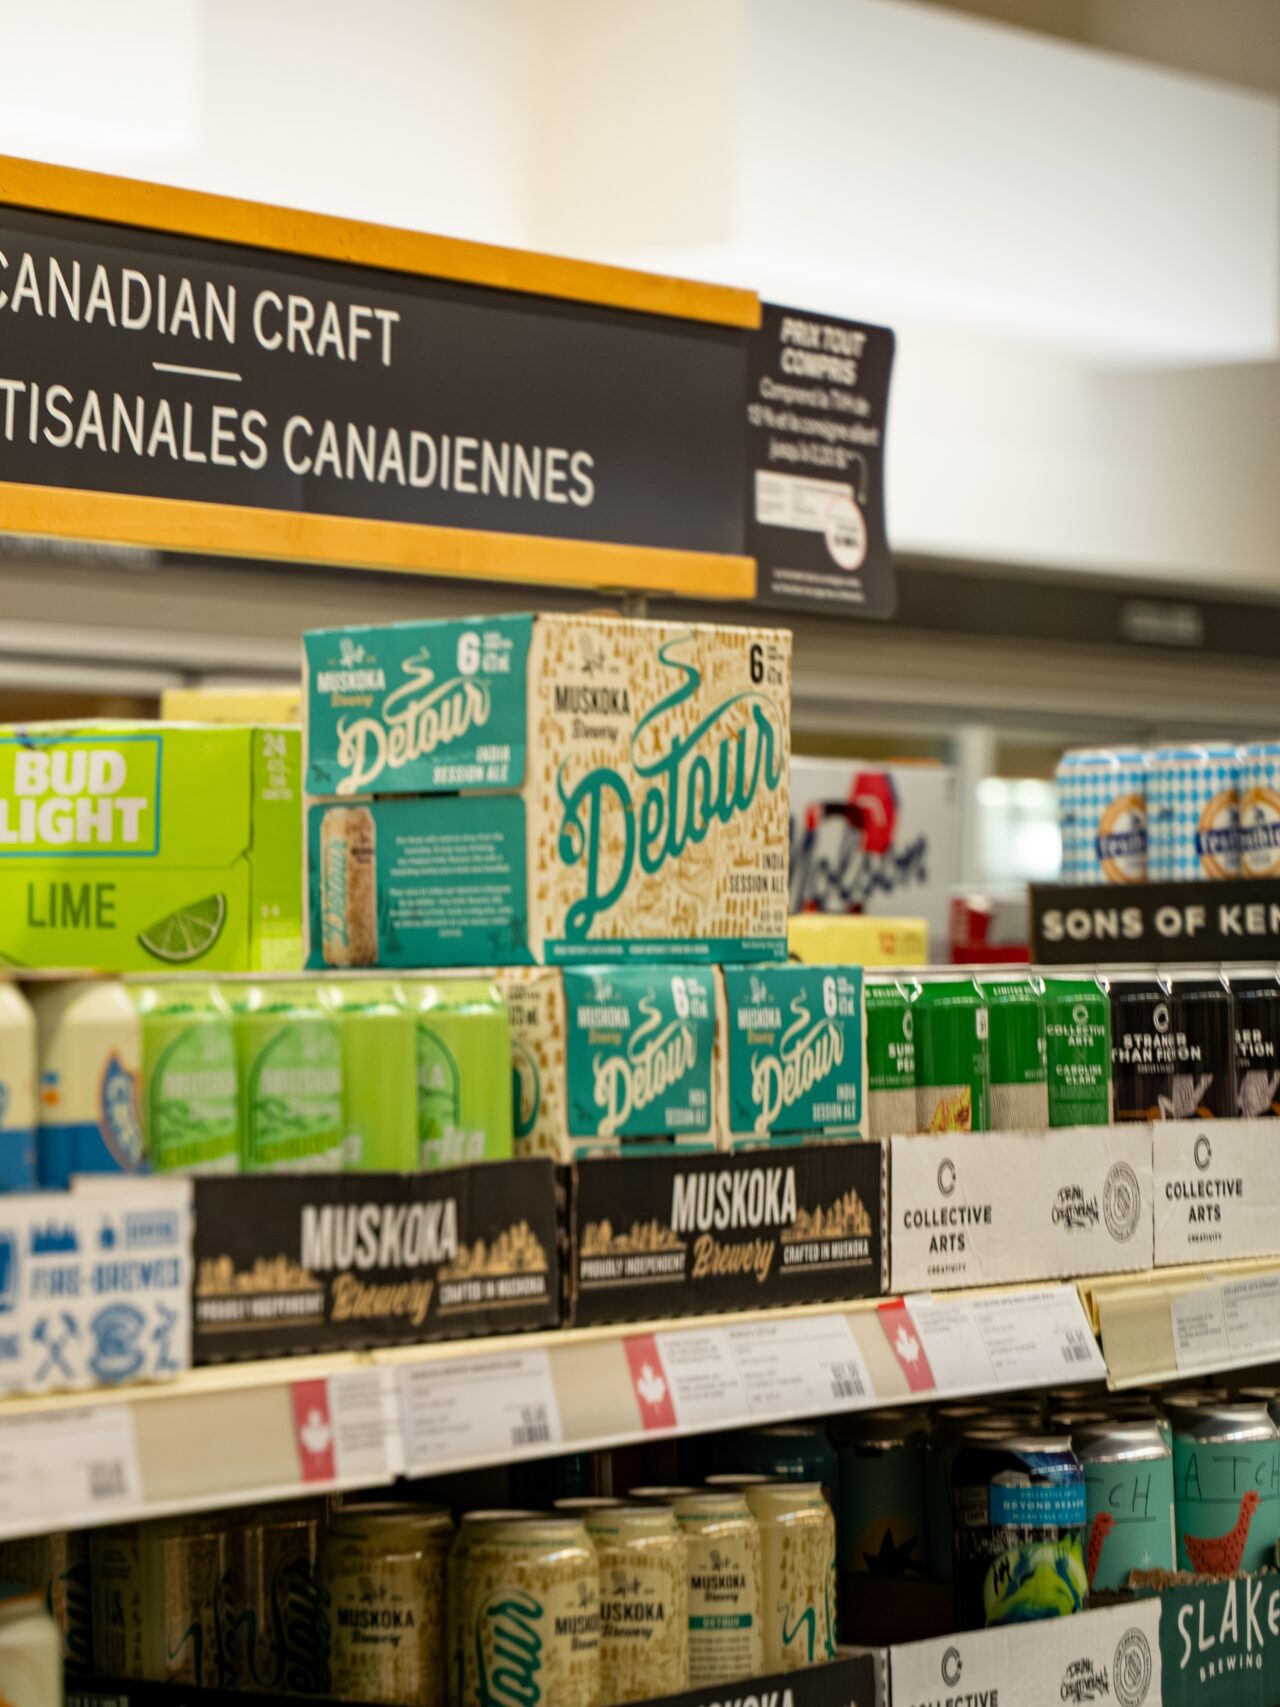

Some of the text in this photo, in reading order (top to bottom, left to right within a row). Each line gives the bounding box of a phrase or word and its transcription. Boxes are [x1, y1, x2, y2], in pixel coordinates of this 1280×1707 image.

[252, 290, 401, 367] CRAFT
[282, 415, 597, 508] CANADIENNES
[457, 631, 481, 676] 6
[749, 642, 764, 685] 6
[317, 668, 387, 694] MUSKOKA
[554, 685, 630, 716] MUSKOKA
[335, 648, 491, 796] Detour
[13, 750, 127, 797] BUD
[486, 764, 509, 783] ALE
[557, 640, 784, 940] Detour
[728, 873, 769, 894] SESSION
[27, 883, 117, 930] LIME
[1043, 906, 1143, 942] SONS
[1155, 904, 1206, 938] OF
[671, 976, 691, 1018] 6
[822, 975, 838, 1017] 6
[737, 1007, 782, 1030] MUSKOKA
[1046, 1023, 1106, 1037] COLLECTIVE
[1067, 1035, 1094, 1047] ARTS
[593, 986, 697, 1137] Detour
[751, 988, 845, 1136] Detour
[671, 1166, 797, 1232] MUSKOKA
[1165, 1178, 1243, 1200] COLLECTIVE
[903, 1204, 992, 1230] COLLECTIVE
[1188, 1204, 1222, 1224] ARTS
[301, 1199, 458, 1271] MUSKOKA
[928, 1233, 966, 1254] ARTS
[1187, 1231, 1223, 1245] CREATIVITY
[624, 1253, 686, 1275] INDEPENDENT
[691, 1234, 775, 1283] Brewery
[783, 1239, 870, 1265] CRAFTED IN MUSKOKA
[926, 1262, 968, 1276] CREATIVITY
[330, 1273, 434, 1327] Brewery
[690, 1574, 747, 1591] MUSKOKA
[337, 1608, 415, 1629] MUSKOKA
[599, 1601, 665, 1622] USKOKA
[1177, 1573, 1280, 1671] SLAKE
[1199, 1652, 1264, 1684] BREWING
